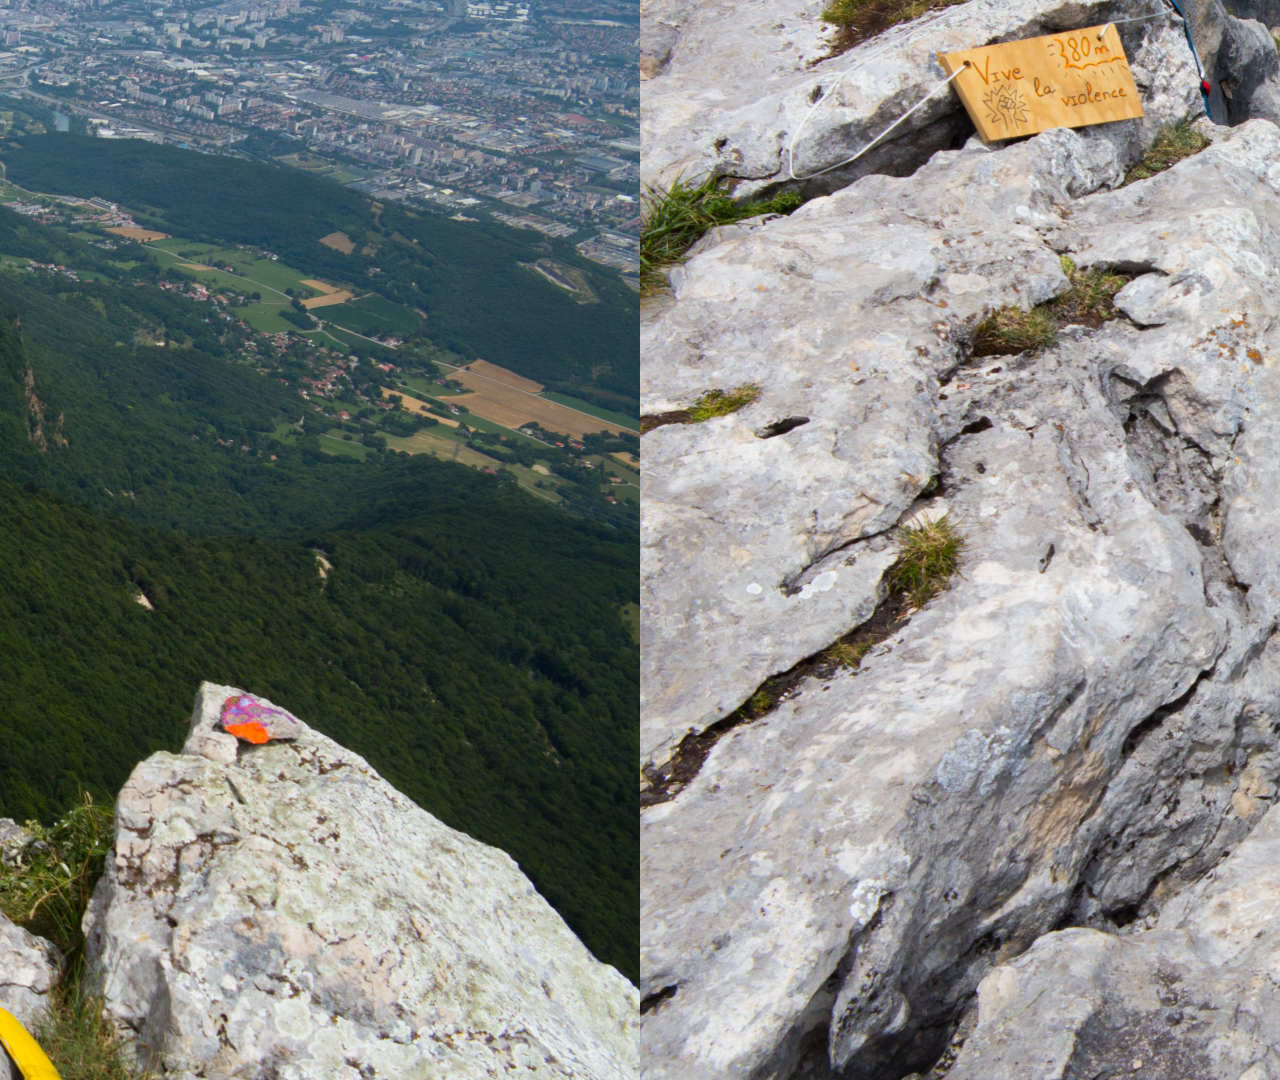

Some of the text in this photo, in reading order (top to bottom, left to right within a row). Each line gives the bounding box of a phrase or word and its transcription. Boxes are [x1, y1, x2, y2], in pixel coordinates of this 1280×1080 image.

[972, 55, 1024, 85] Vive
[1033, 77, 1056, 97] la
[1060, 82, 1127, 107] violence
